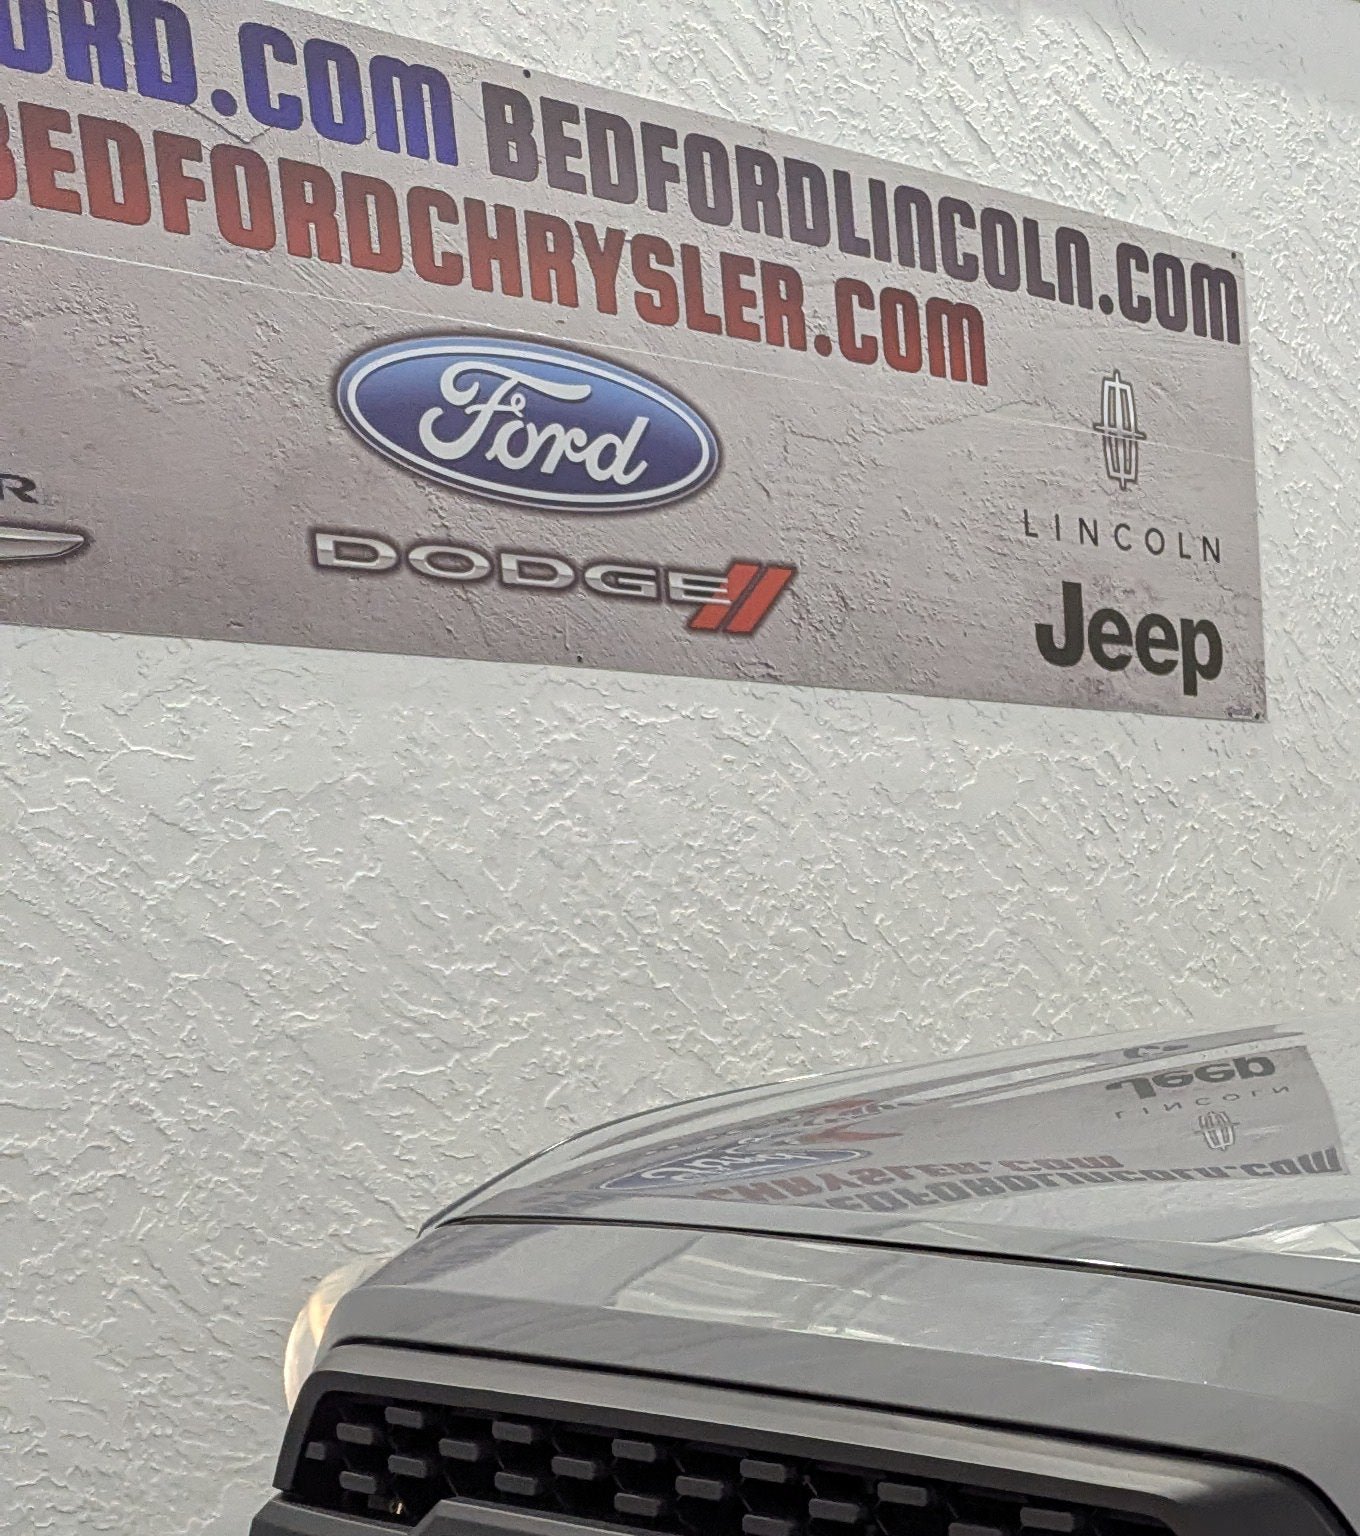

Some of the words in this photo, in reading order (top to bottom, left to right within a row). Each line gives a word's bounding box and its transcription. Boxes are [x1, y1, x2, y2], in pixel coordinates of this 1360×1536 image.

[481, 82, 1241, 345] BEDFORDLINCOLN.COM
[419, 360, 649, 486] Ford
[315, 532, 731, 605] DODGE
[1023, 508, 1222, 565] LINCOLN
[1034, 580, 1224, 697] Jeep
